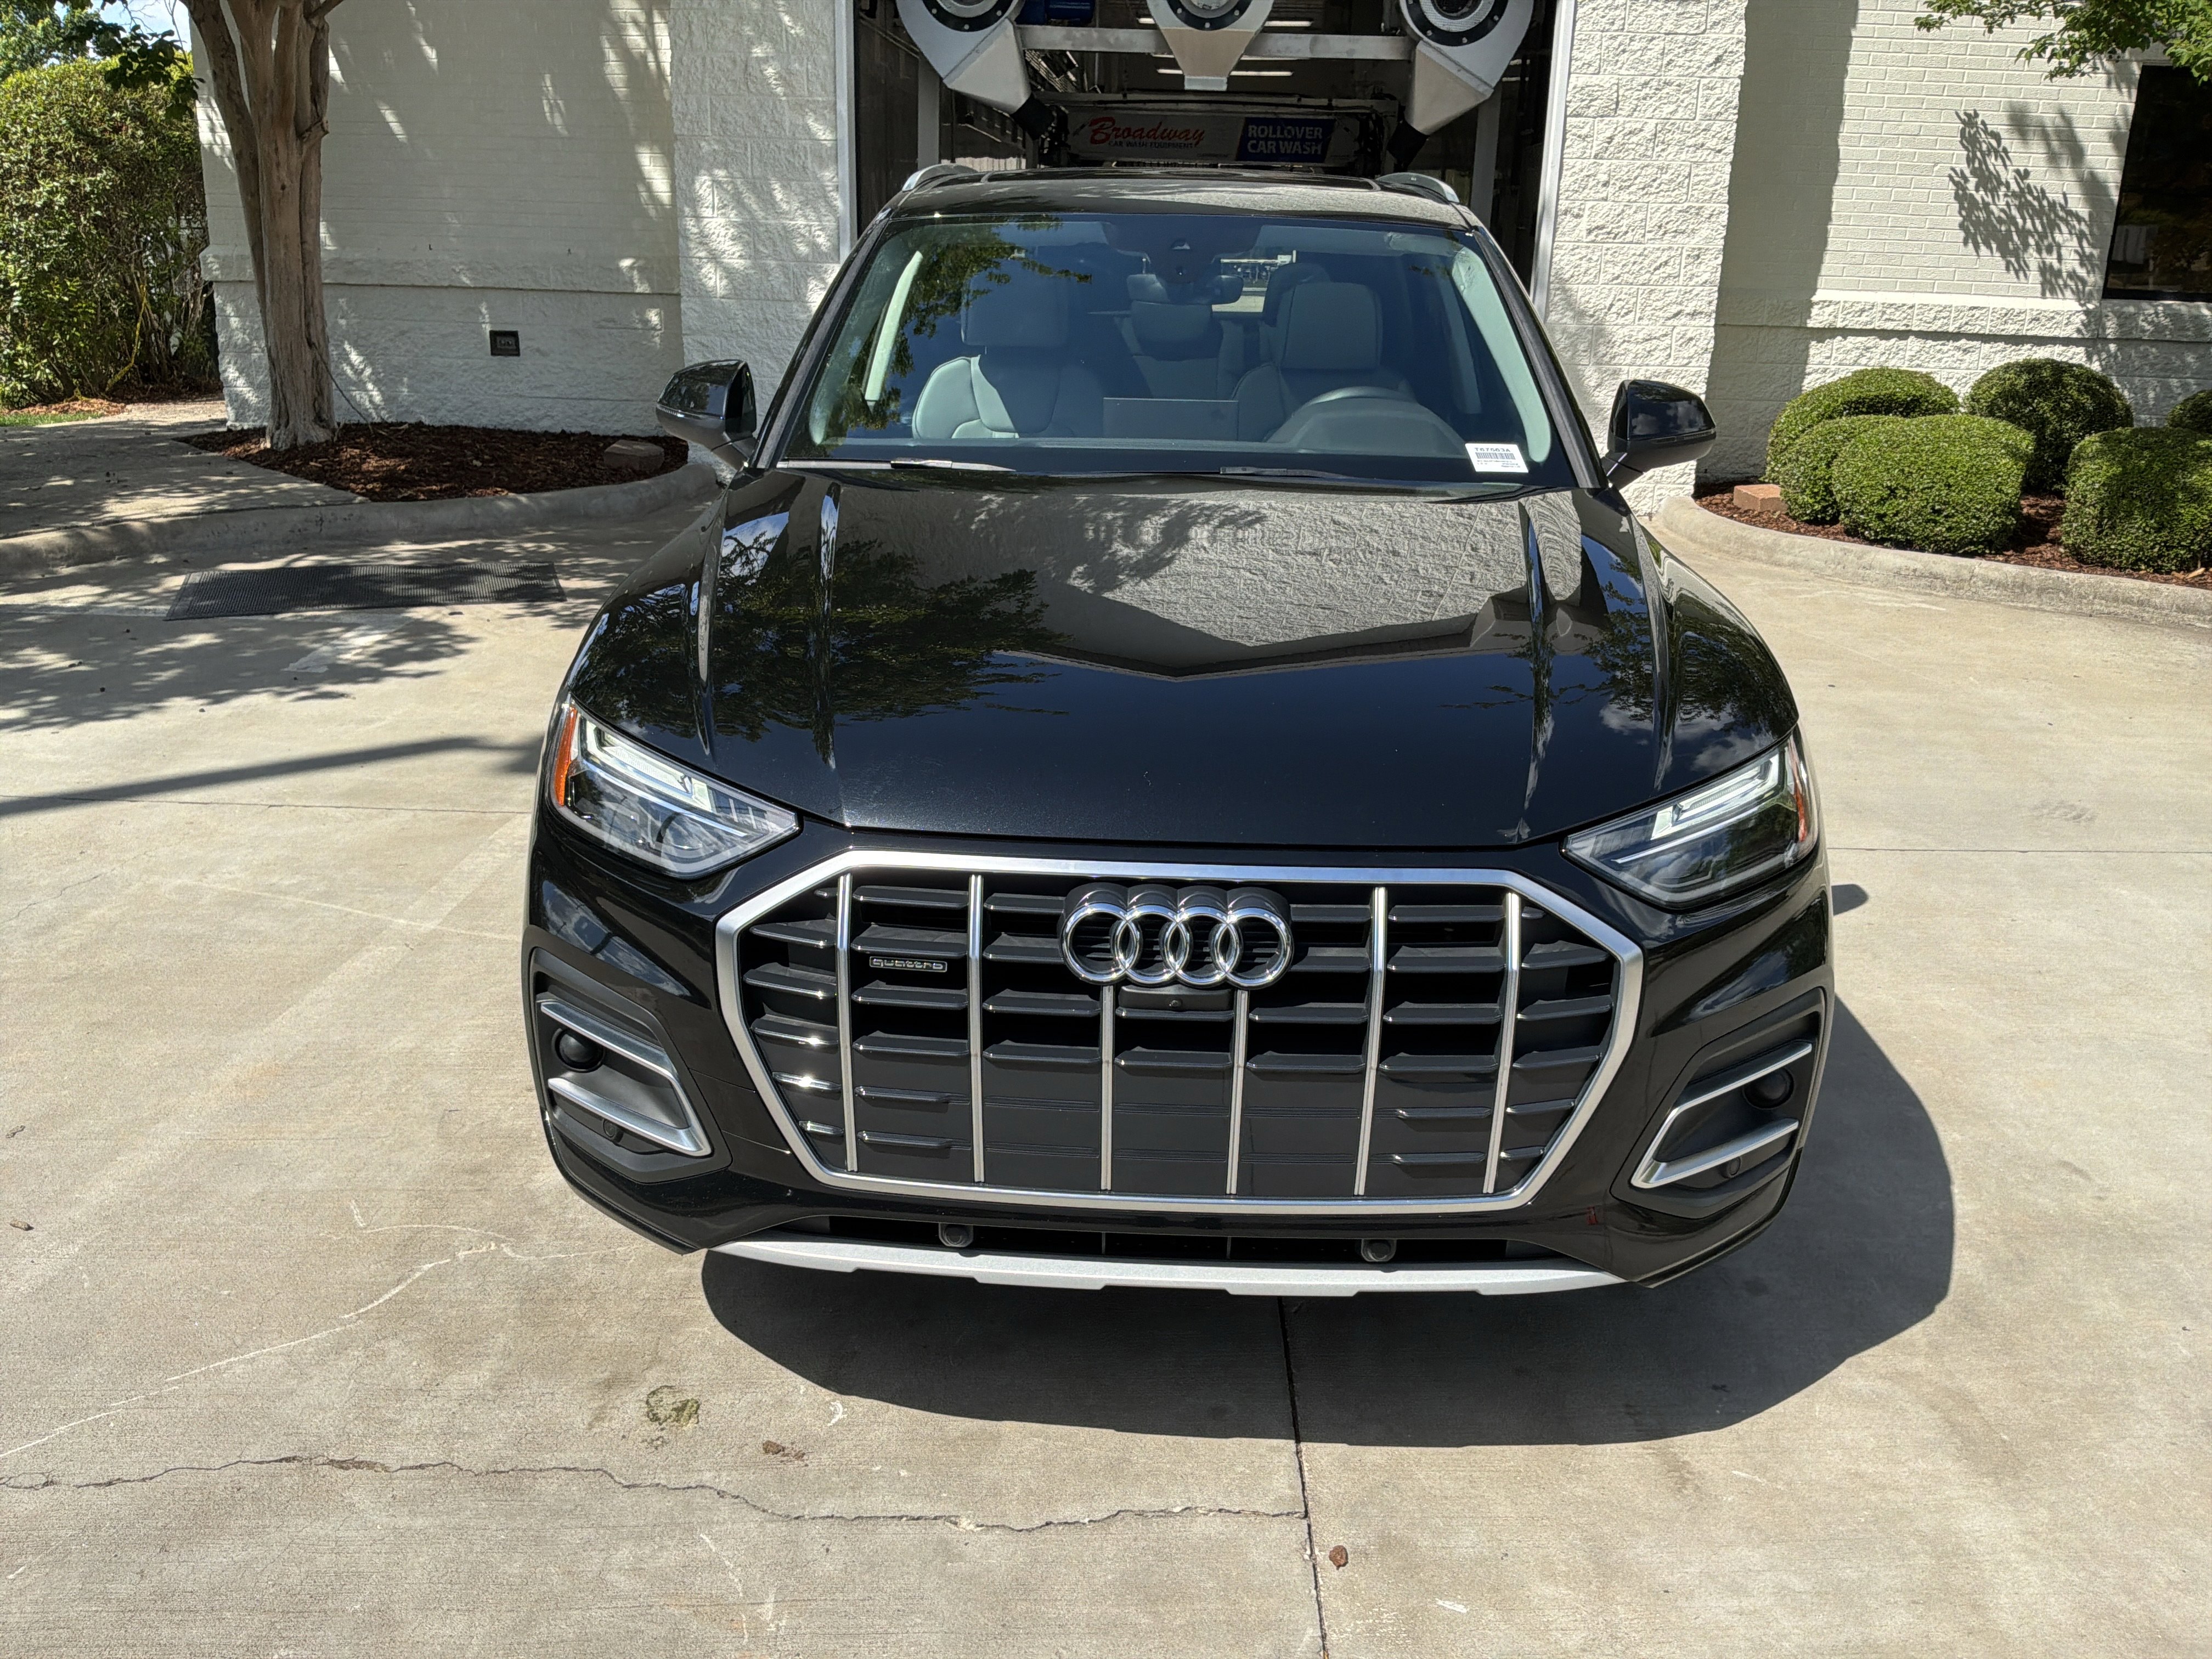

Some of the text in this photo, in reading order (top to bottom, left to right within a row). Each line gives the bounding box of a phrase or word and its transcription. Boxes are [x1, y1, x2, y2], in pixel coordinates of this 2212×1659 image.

[1088, 116, 1205, 148] Broadway
[1248, 125, 1323, 139] ROLLOVER
[1247, 140, 1323, 155] CAR WASH
[872, 958, 943, 969] quattro
